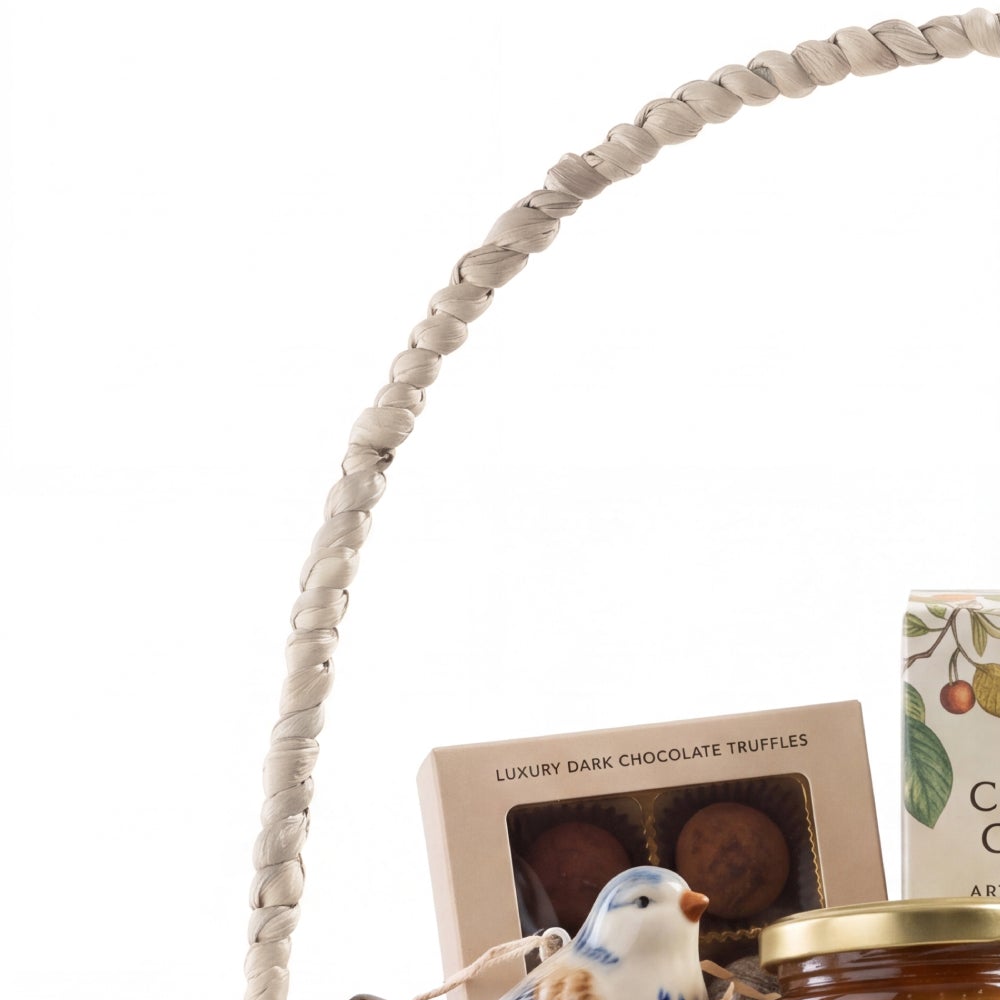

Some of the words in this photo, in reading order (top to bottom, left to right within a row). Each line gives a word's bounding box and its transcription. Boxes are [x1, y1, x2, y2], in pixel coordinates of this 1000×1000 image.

[496, 762, 560, 782] LUXURY
[567, 756, 613, 773] DARK
[618, 744, 722, 767] CHOCOLATE
[726, 733, 808, 754] TRUFFLES
